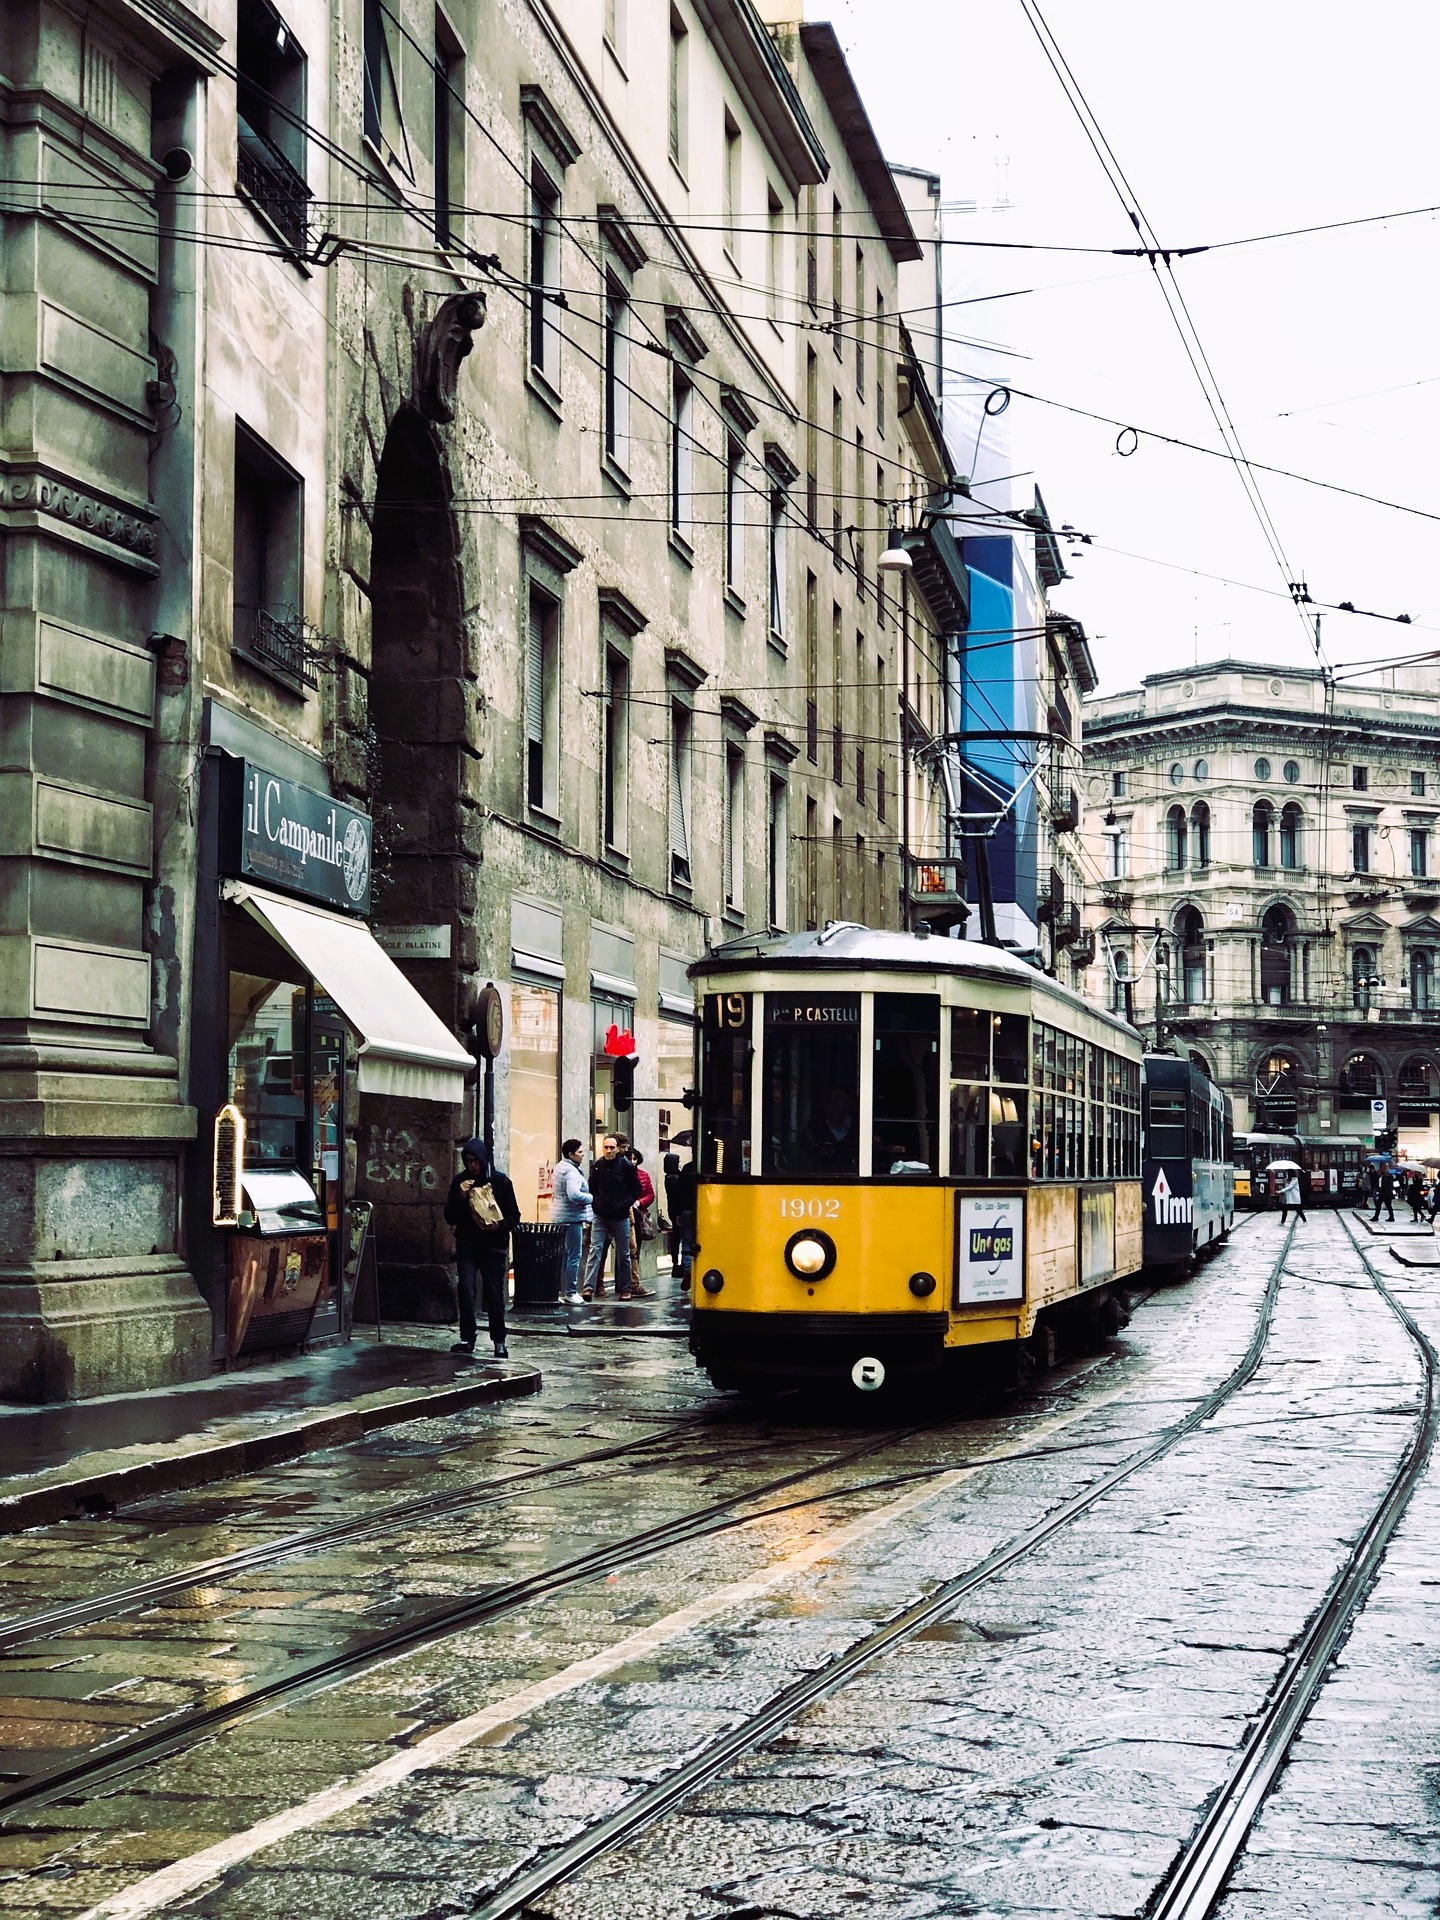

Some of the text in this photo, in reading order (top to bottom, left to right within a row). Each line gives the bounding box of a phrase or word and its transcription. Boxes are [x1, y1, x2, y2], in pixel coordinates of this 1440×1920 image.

[247, 773, 259, 835] il
[264, 780, 343, 868] Campanile
[388, 927, 426, 935] PASSAGGIO
[405, 941, 442, 949] PALATINE
[716, 992, 745, 1029] 19
[806, 1007, 858, 1022] CASTELLI
[780, 1198, 840, 1218] 1902
